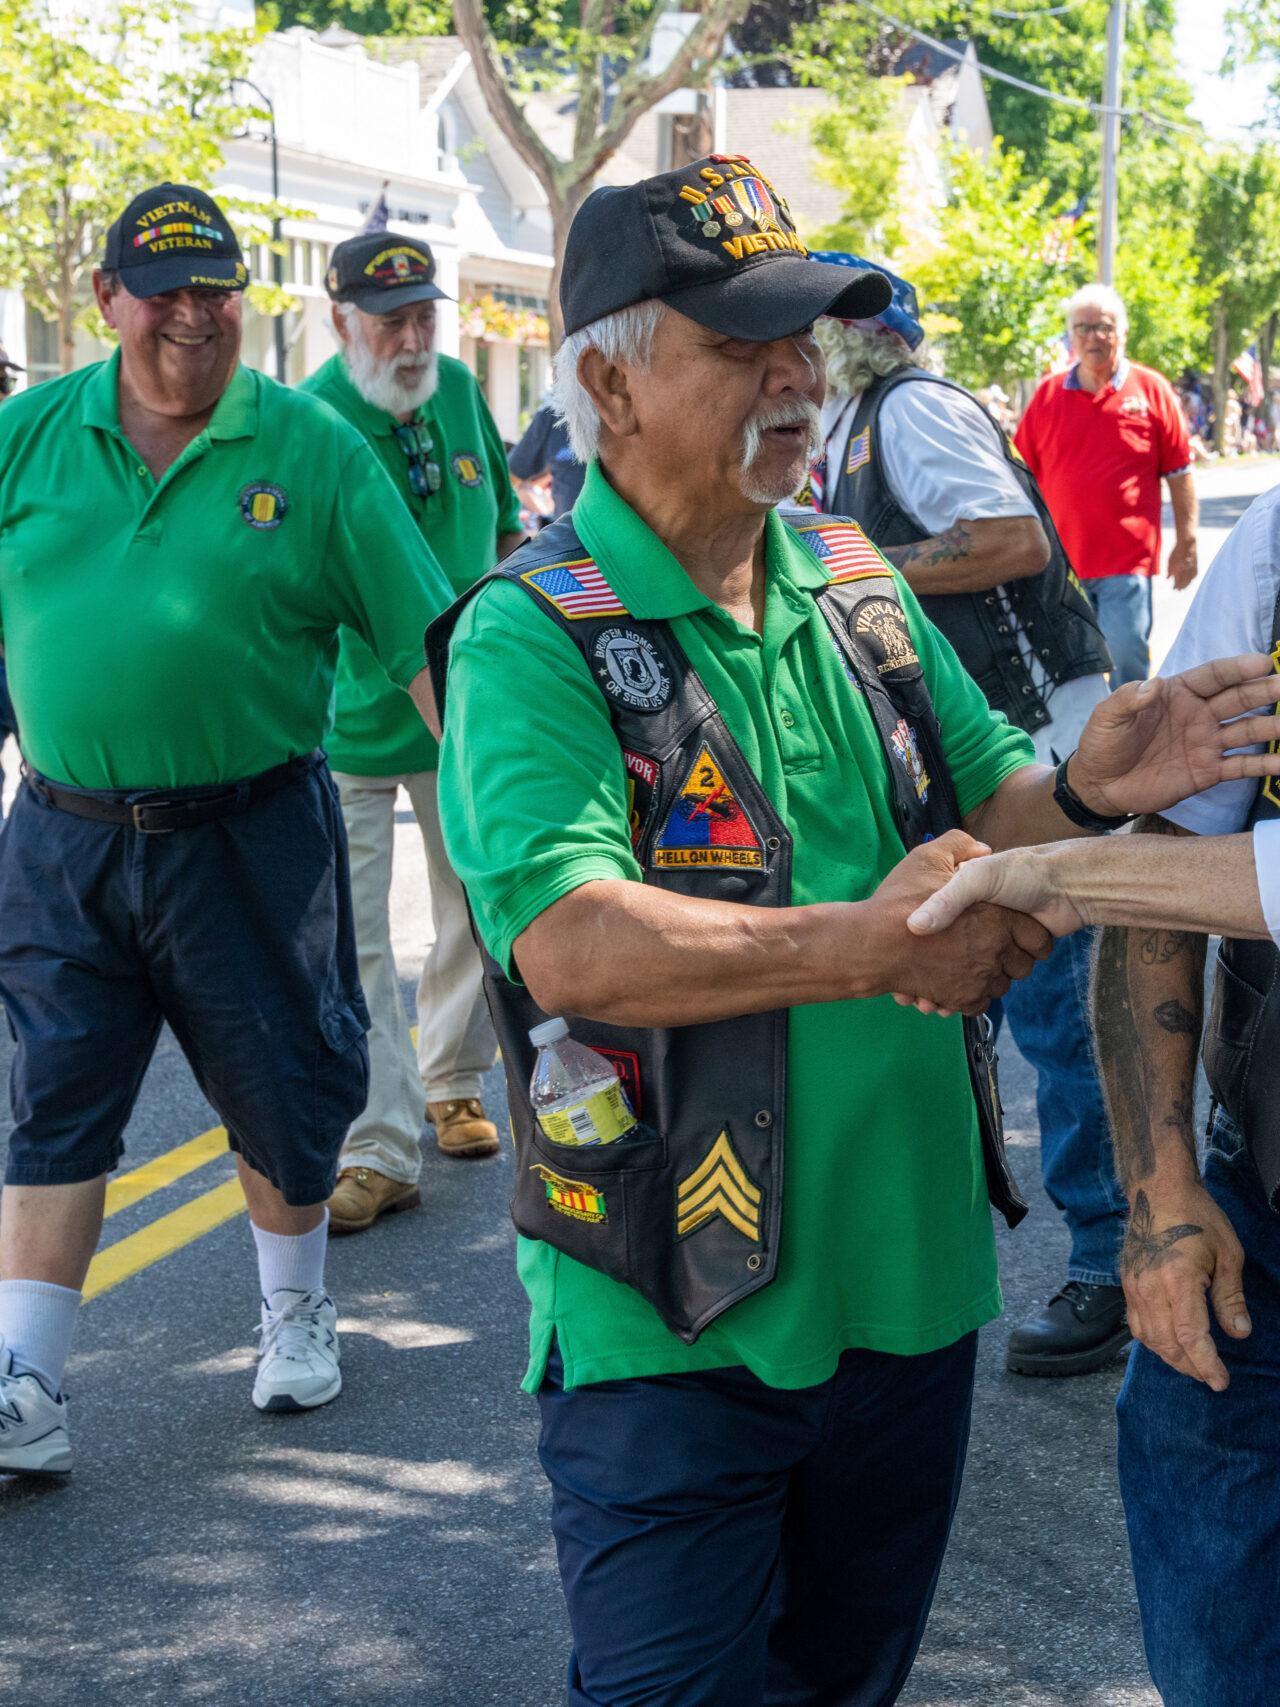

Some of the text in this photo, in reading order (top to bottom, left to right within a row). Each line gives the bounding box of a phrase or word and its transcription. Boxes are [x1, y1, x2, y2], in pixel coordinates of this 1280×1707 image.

[136, 202, 211, 228] VIETNAM
[149, 236, 212, 253] VETERAN
[856, 602, 907, 633] VIETNAM
[606, 680, 622, 697] OR
[622, 692, 650, 708] SEND
[649, 694, 664, 707] US
[658, 675, 671, 700] BACK
[700, 766, 715, 787] 2
[657, 850, 760, 865] HELL ON WHEELS
